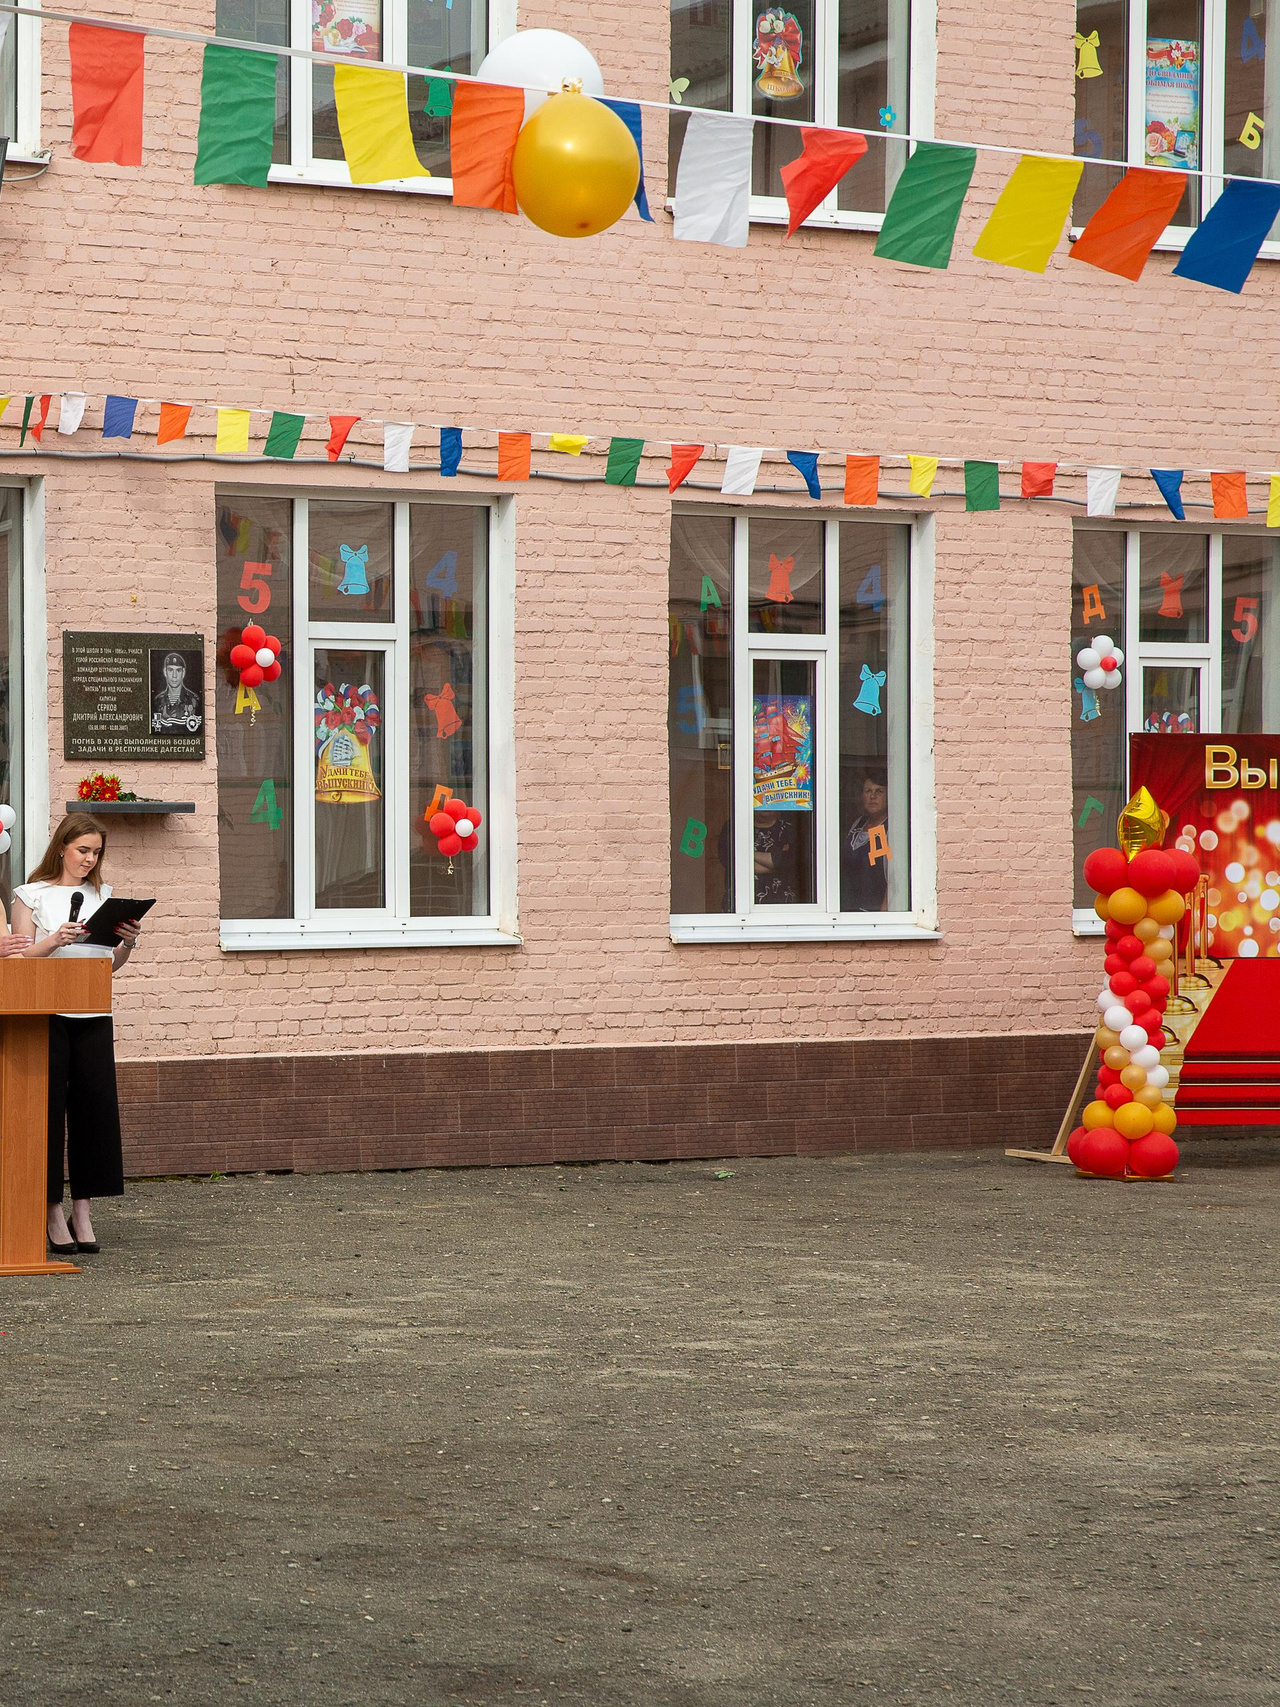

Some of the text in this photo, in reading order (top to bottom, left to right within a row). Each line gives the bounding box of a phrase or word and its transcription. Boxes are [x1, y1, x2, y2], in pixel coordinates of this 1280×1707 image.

[1238, 112, 1266, 150] Б
[236, 560, 272, 614] 5
[426, 550, 458, 600] 4
[700, 574, 722, 612] А
[856, 564, 886, 613] 4
[1082, 584, 1107, 625] Д
[1230, 596, 1258, 644] 5
[73, 712, 98, 722] ДМИТРИЙ
[234, 679, 262, 714] А
[676, 685, 705, 735] 5
[249, 778, 284, 830] 4
[316, 778, 375, 792] ВЫПУСКНИК!
[753, 779, 795, 794] УДАЧИ ТЕБЕ,
[765, 792, 810, 802] ВЫПУСКНИК!
[1078, 794, 1104, 828] Г
[679, 816, 708, 860] В
[867, 824, 893, 866] Д
